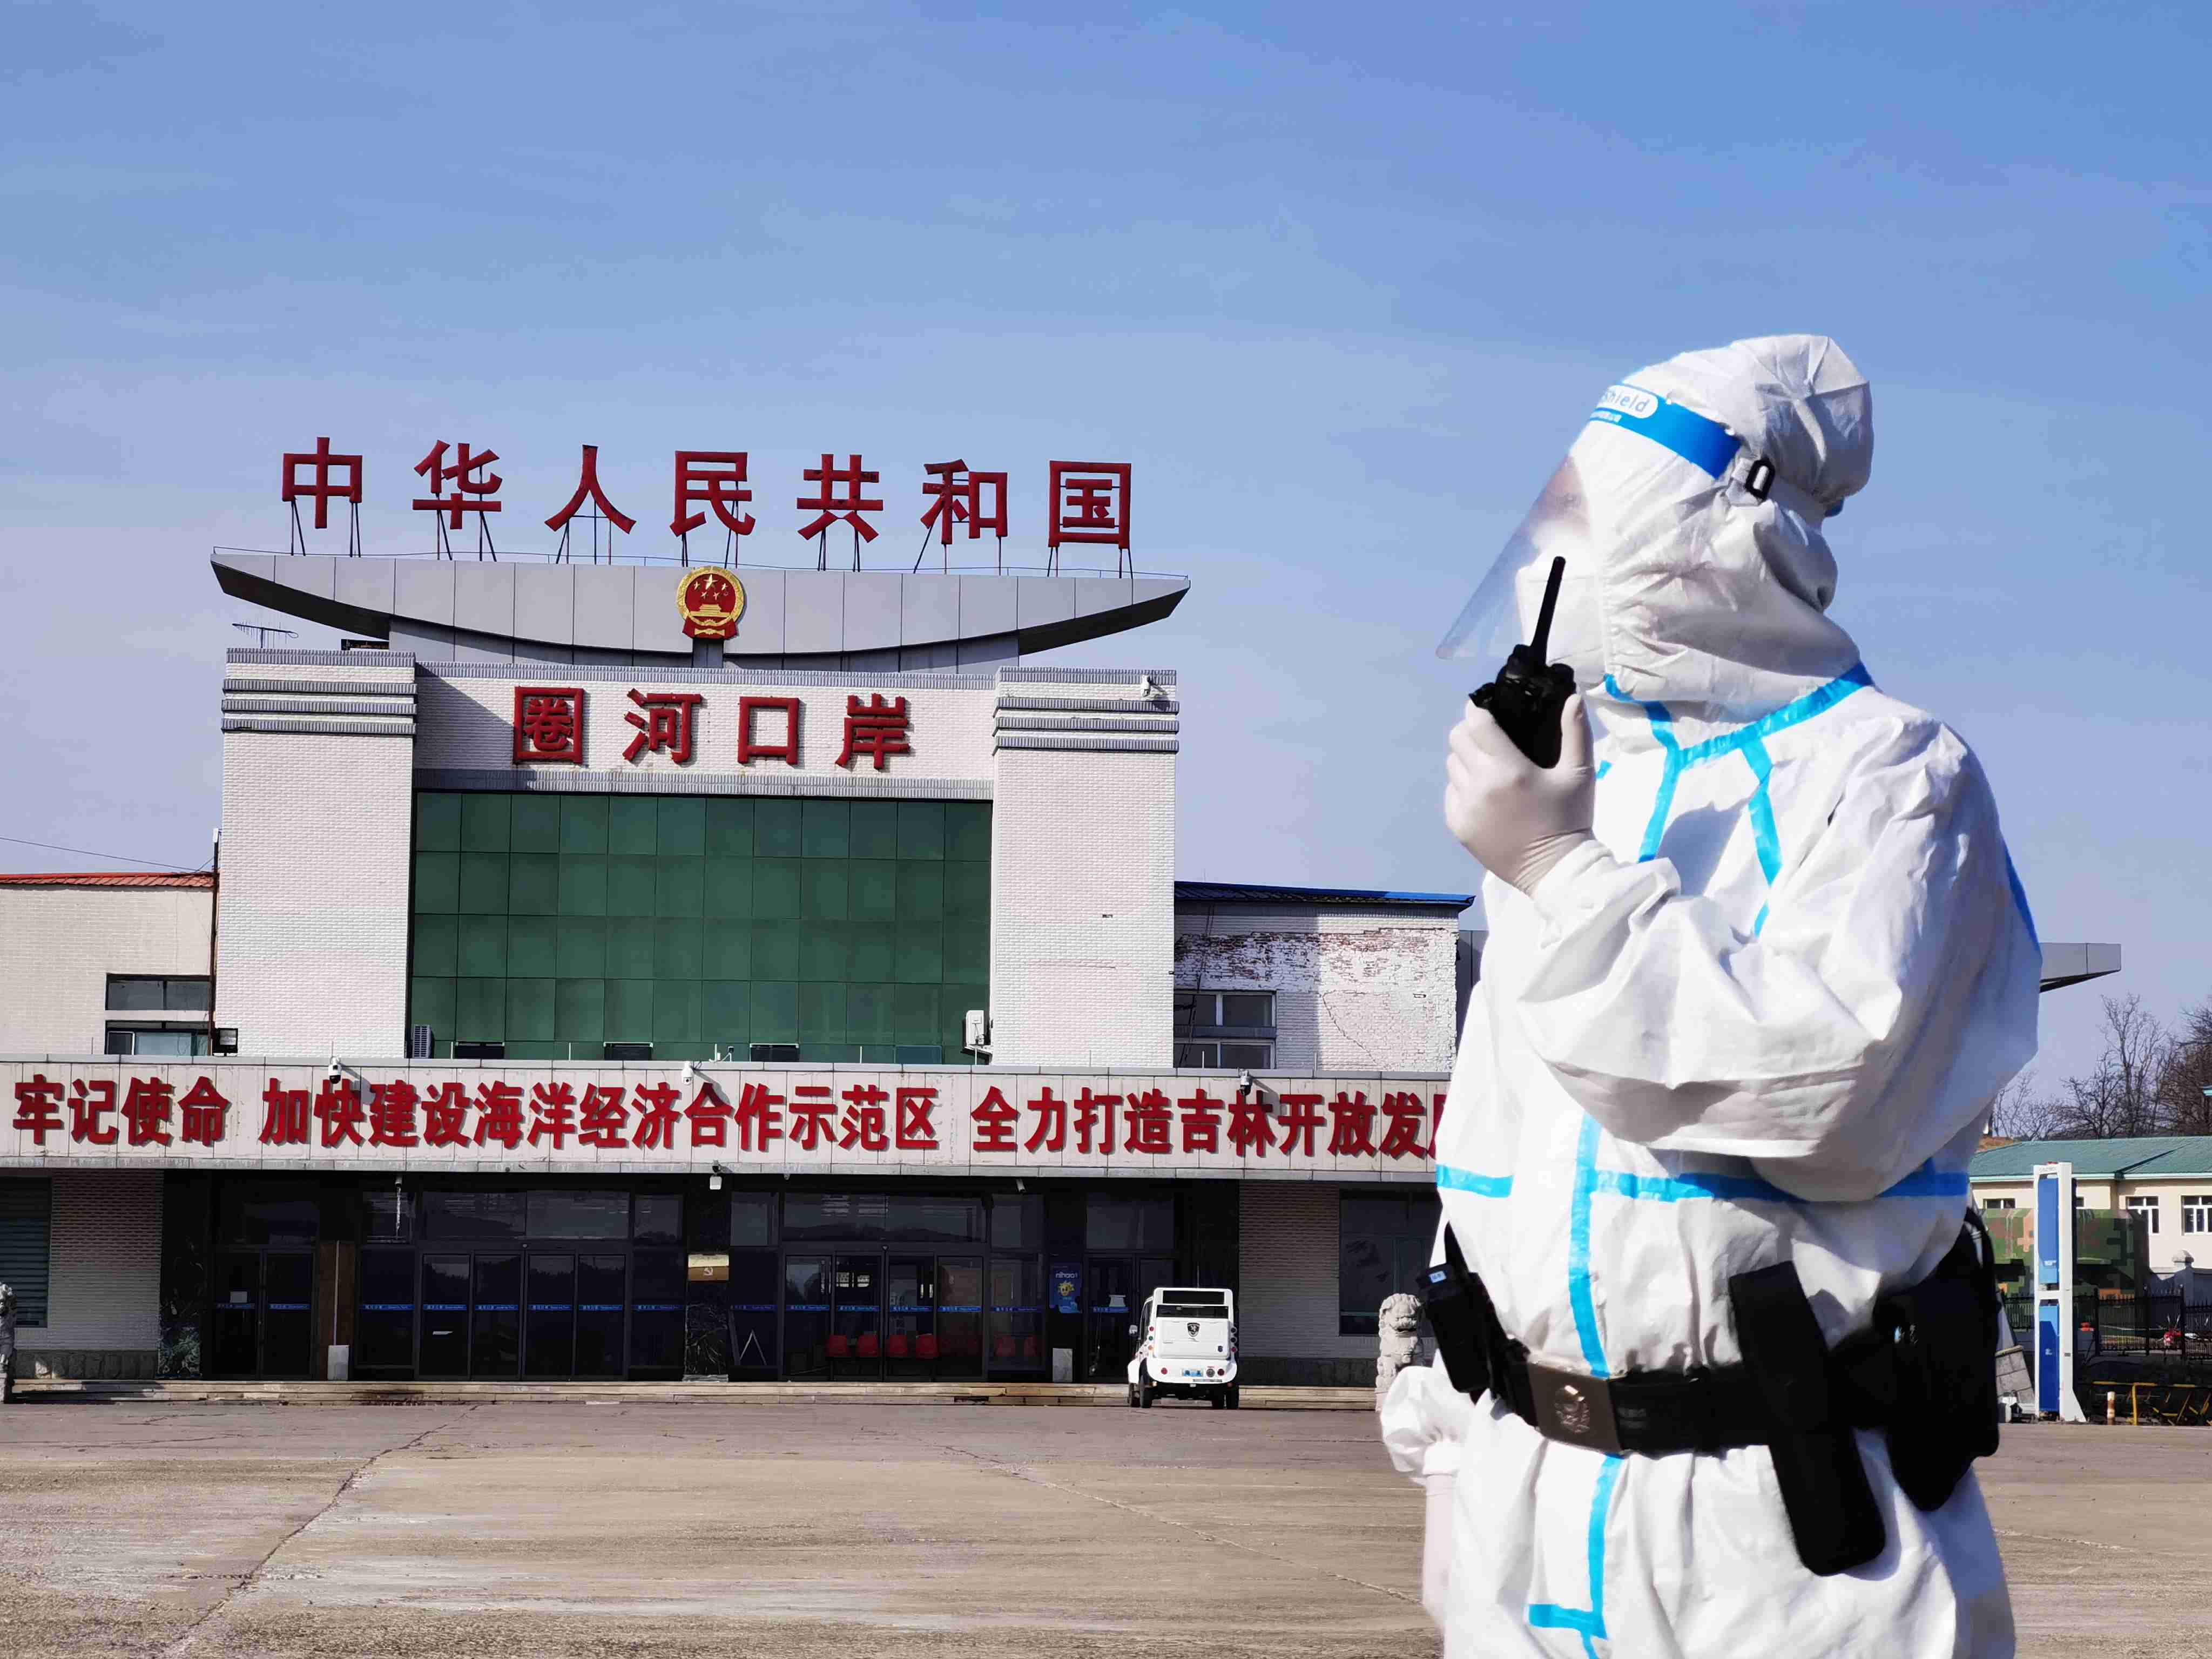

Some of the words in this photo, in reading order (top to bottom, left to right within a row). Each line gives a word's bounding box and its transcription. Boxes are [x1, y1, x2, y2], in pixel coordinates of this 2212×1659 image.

[281, 436, 1132, 549] 中华人民共和国
[512, 686, 910, 770] 圈河口岸
[12, 1074, 229, 1146] 牢记使命
[259, 1077, 939, 1151] 加快建设海洋经济合作示范区
